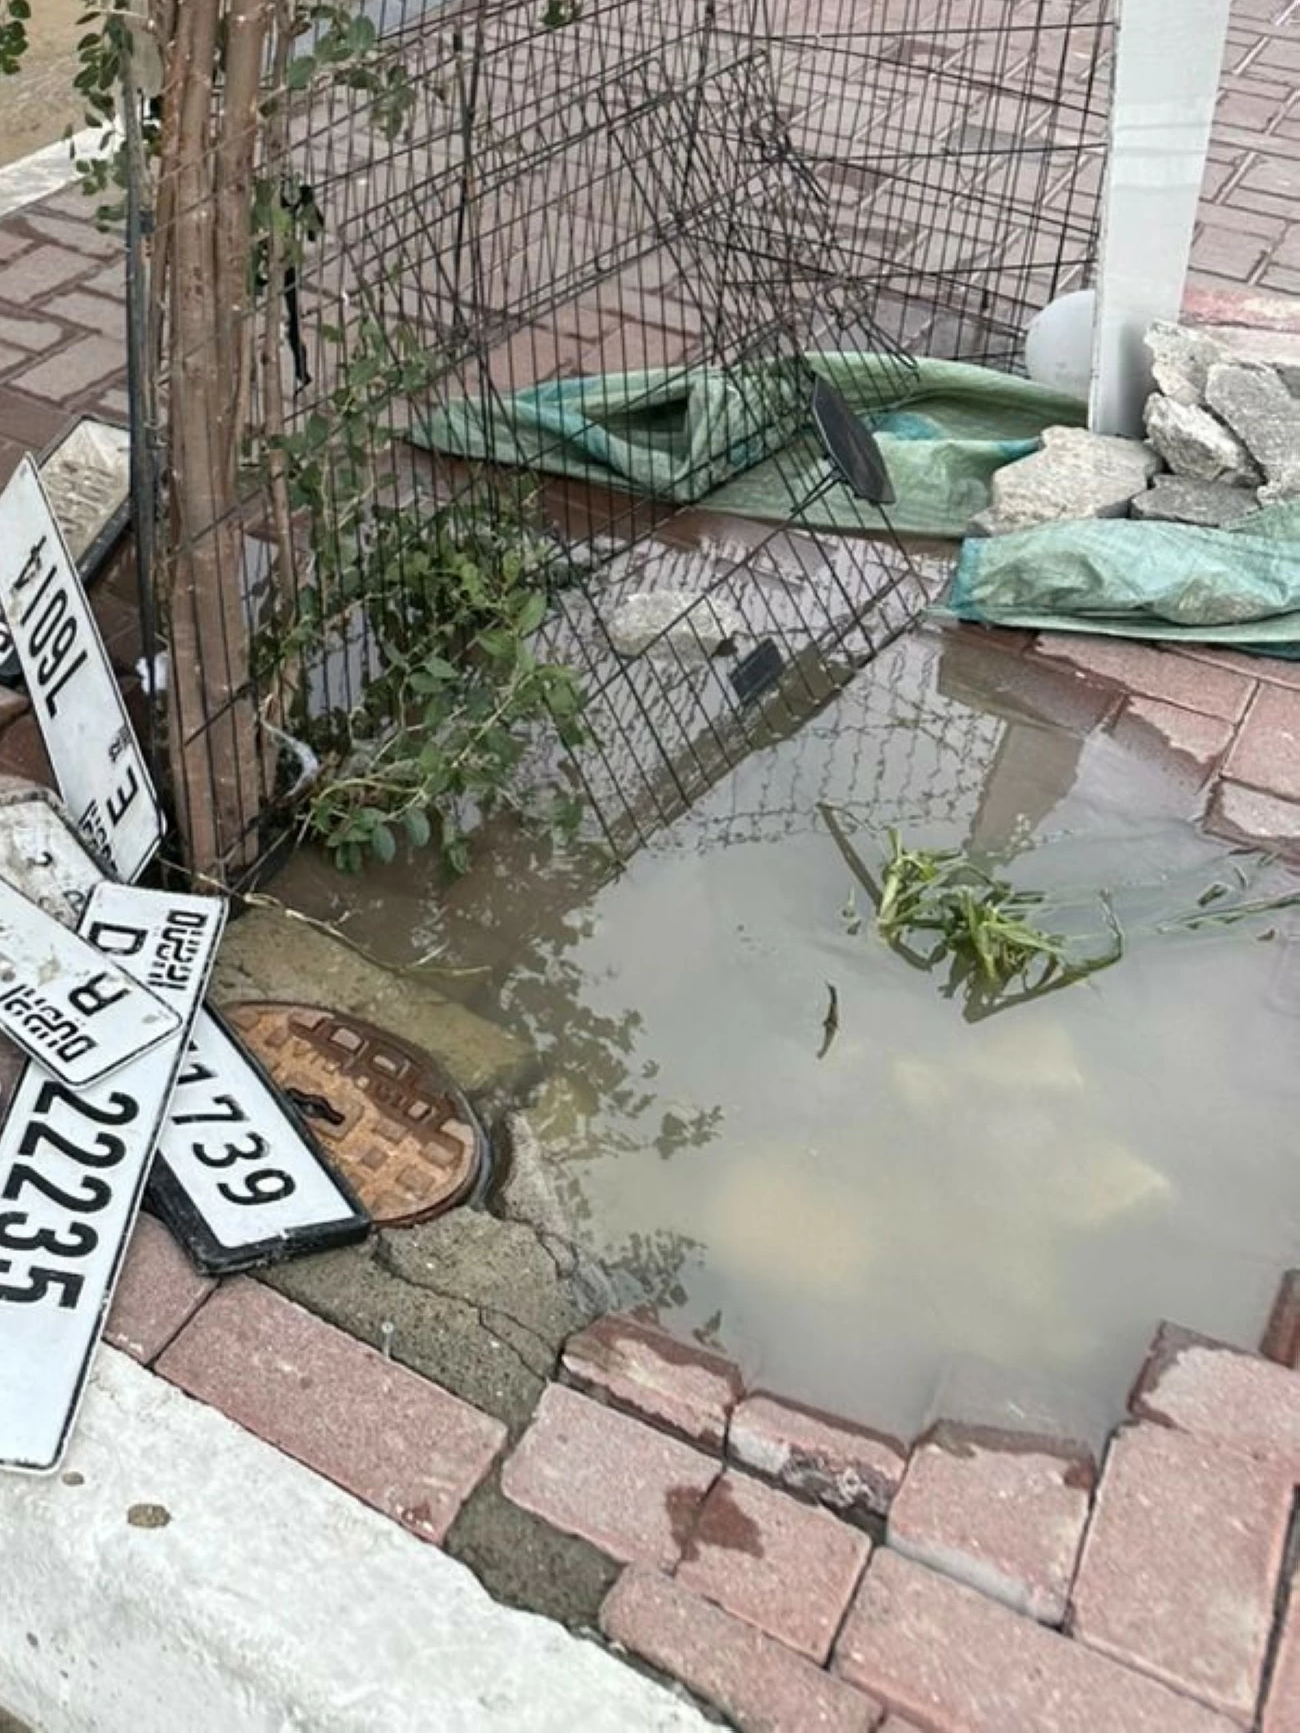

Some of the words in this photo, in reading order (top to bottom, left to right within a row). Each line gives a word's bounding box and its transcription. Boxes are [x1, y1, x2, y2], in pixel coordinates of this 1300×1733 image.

[105, 766, 139, 827] E
[88, 921, 149, 957] D
[67, 972, 132, 1017] R
